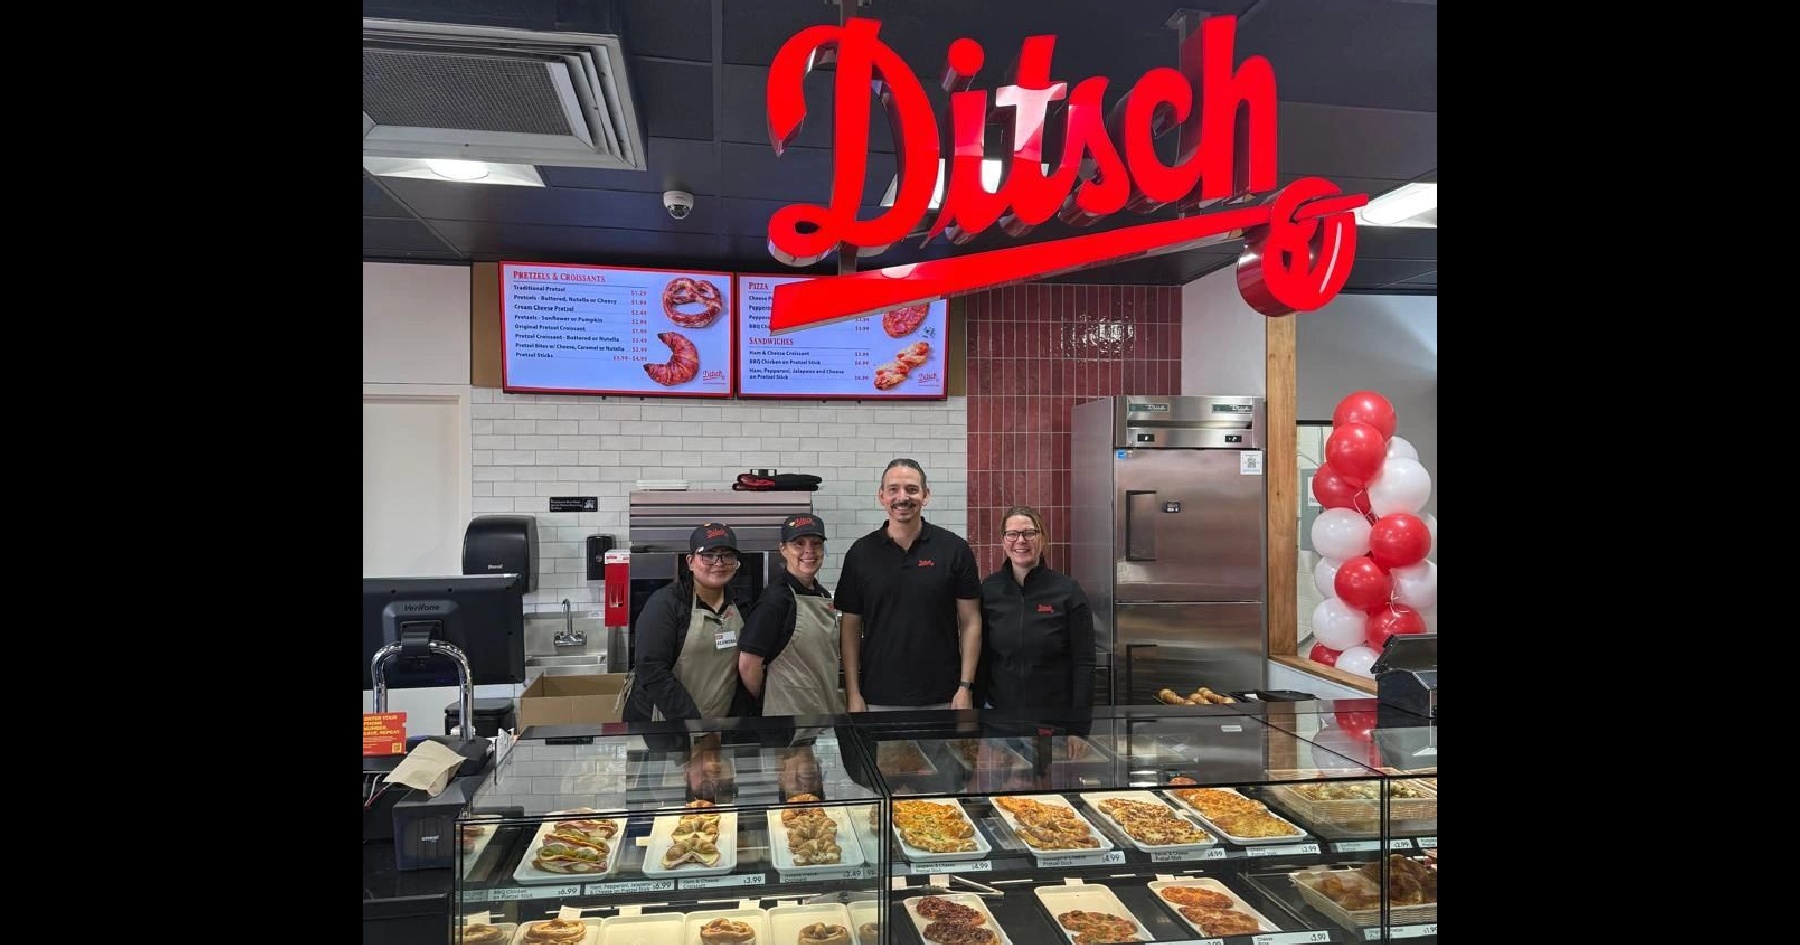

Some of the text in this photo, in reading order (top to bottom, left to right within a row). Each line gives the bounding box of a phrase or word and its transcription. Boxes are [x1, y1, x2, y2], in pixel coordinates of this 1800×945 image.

[768, 15, 1278, 260] Ditsch
[513, 270, 551, 280] PRETZELS
[560, 272, 606, 282] CROISSANTS
[748, 282, 768, 290] PIZZA
